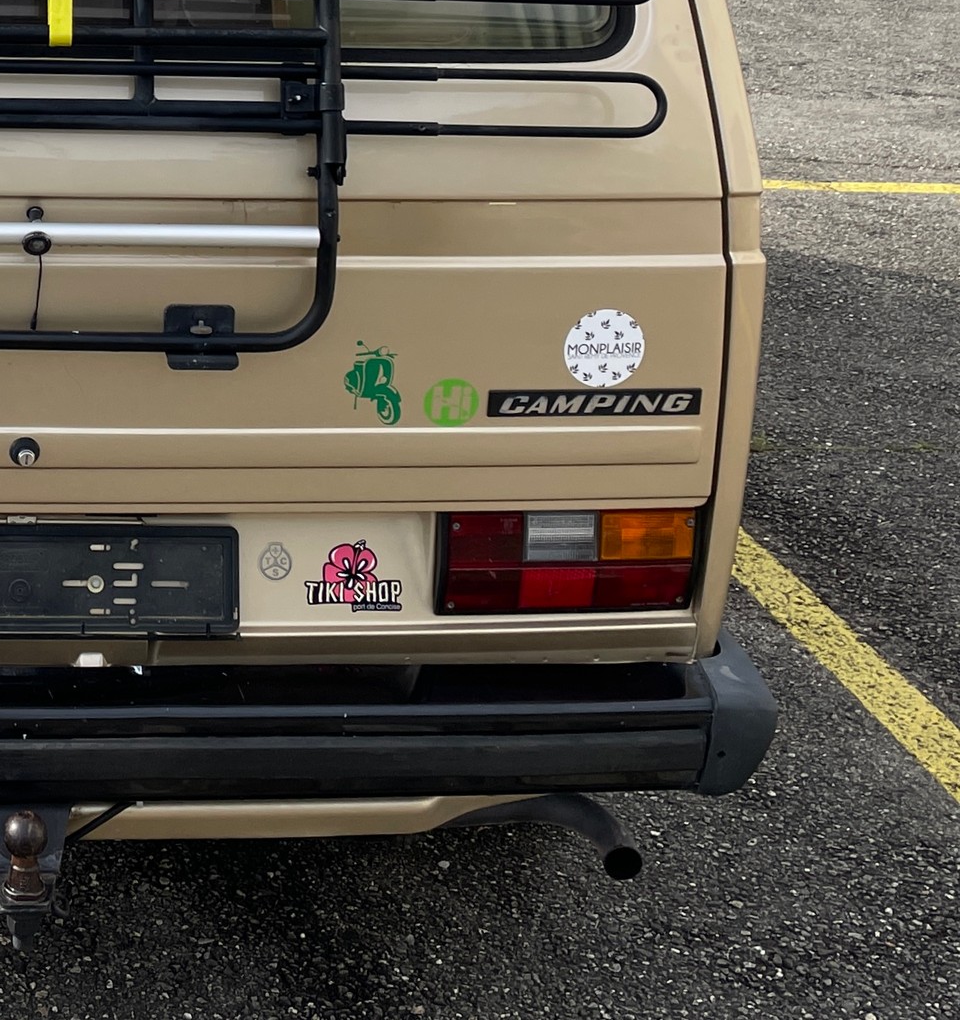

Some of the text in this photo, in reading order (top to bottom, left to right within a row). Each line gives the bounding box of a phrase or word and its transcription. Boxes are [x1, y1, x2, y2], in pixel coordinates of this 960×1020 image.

[567, 342, 642, 356] MONPLAISIR
[498, 392, 694, 415] CAMPING
[305, 581, 401, 604] TIKI SHOP
